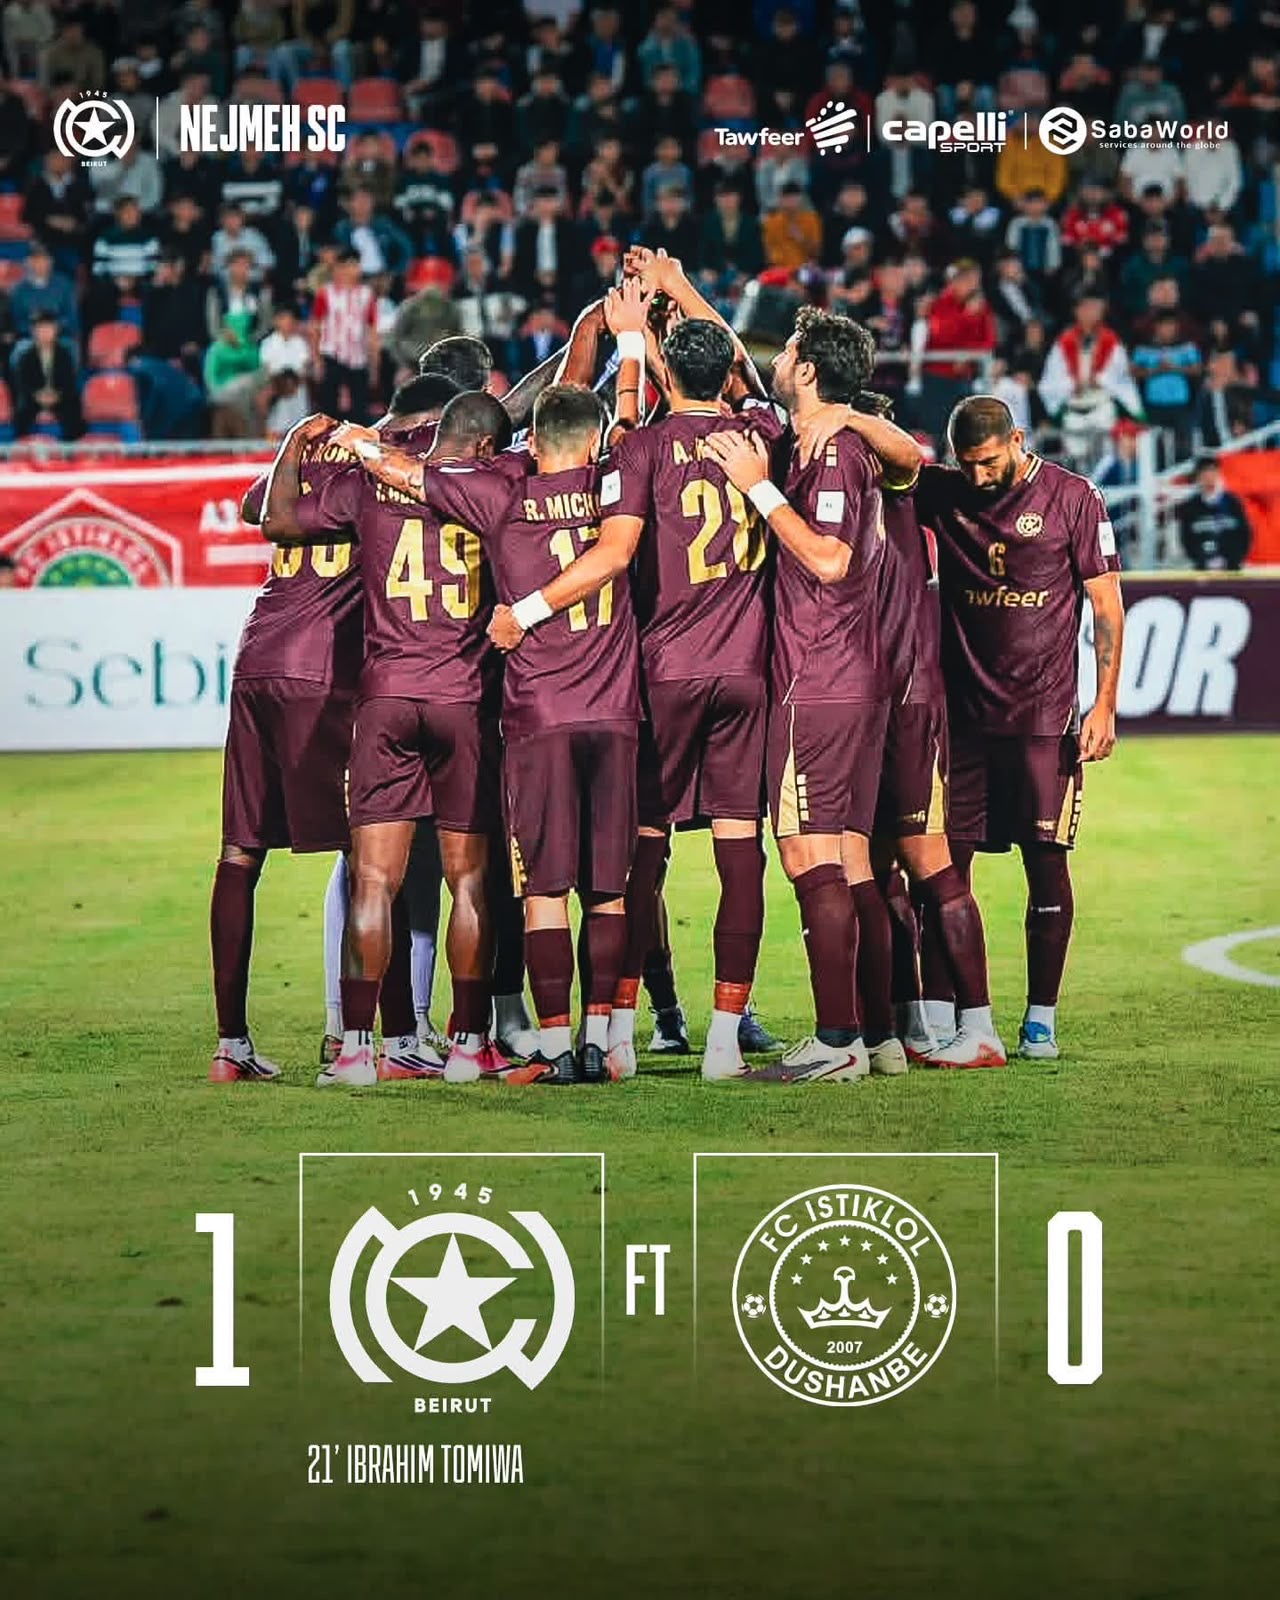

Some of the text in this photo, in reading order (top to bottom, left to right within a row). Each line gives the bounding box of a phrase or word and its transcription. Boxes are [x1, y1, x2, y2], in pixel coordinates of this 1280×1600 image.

[523, 498, 545, 521] R.
[386, 518, 482, 623] 49
[988, 541, 1006, 577] 6
